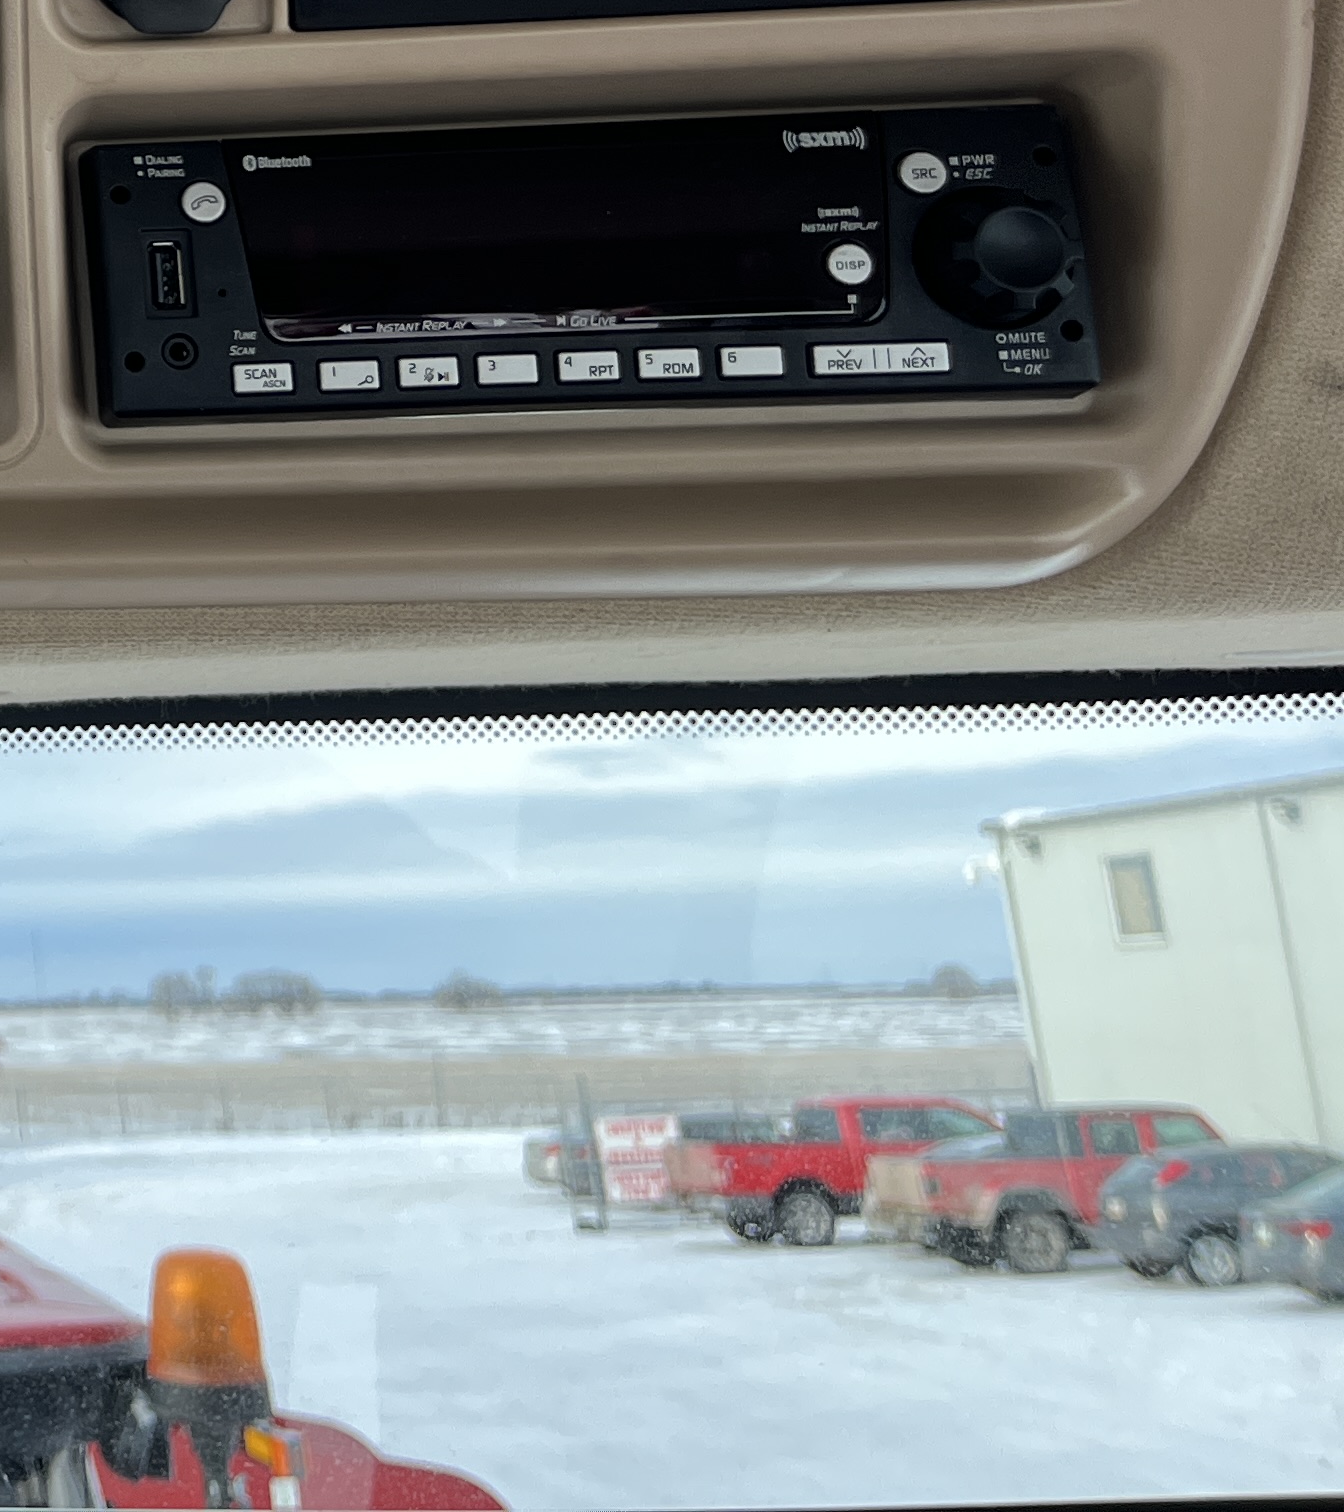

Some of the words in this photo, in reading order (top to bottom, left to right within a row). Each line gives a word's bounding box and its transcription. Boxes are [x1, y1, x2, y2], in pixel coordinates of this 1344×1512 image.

[256, 154, 312, 169] Bluetooth
[961, 153, 995, 167] PWR
[911, 167, 938, 180] SRC
[965, 167, 993, 180] ESC
[835, 259, 866, 271] DISP
[1008, 331, 1046, 344] MUTE
[644, 353, 654, 365] 5
[727, 351, 737, 364] 6
[1010, 347, 1050, 361] MENU
[408, 362, 417, 374] 2
[487, 359, 496, 372] 3
[563, 356, 573, 368] 4
[662, 362, 694, 375] RDM
[827, 358, 863, 371] PREV
[901, 356, 936, 369] NEXT
[243, 367, 278, 380] SCAN
[588, 364, 614, 377] RPT
[1024, 363, 1043, 376] OK
[262, 379, 287, 388] ASCN
